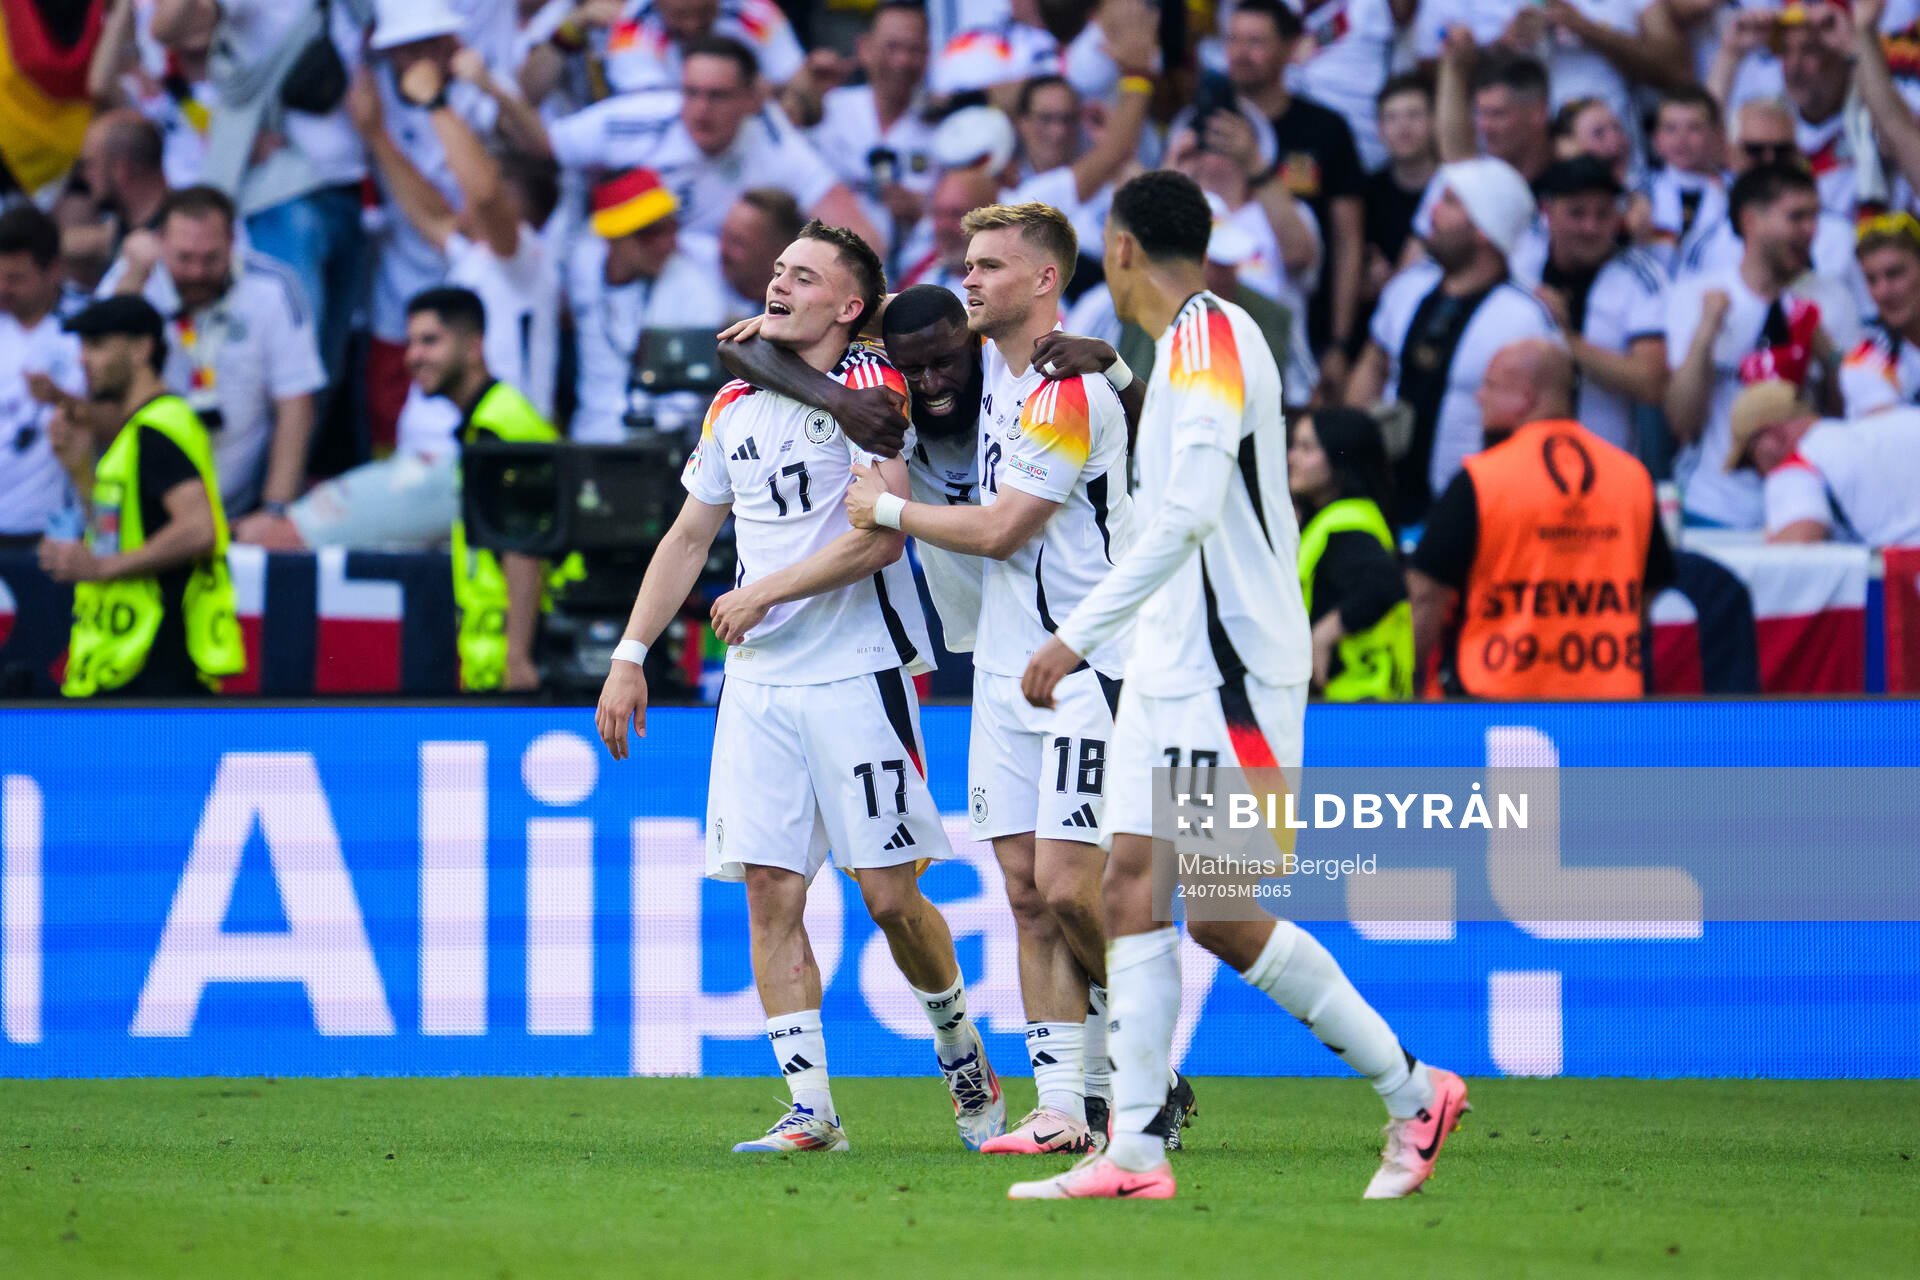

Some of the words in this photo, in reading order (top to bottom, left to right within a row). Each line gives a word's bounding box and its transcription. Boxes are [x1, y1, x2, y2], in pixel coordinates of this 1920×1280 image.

[765, 461, 813, 516] 17
[853, 760, 907, 819] 17
[1054, 736, 1107, 797] 18
[1163, 747, 1219, 808] 10
[130, 731, 1222, 1077] Alipa
[927, 988, 962, 1010] DFB
[1026, 1027, 1051, 1039] FB
